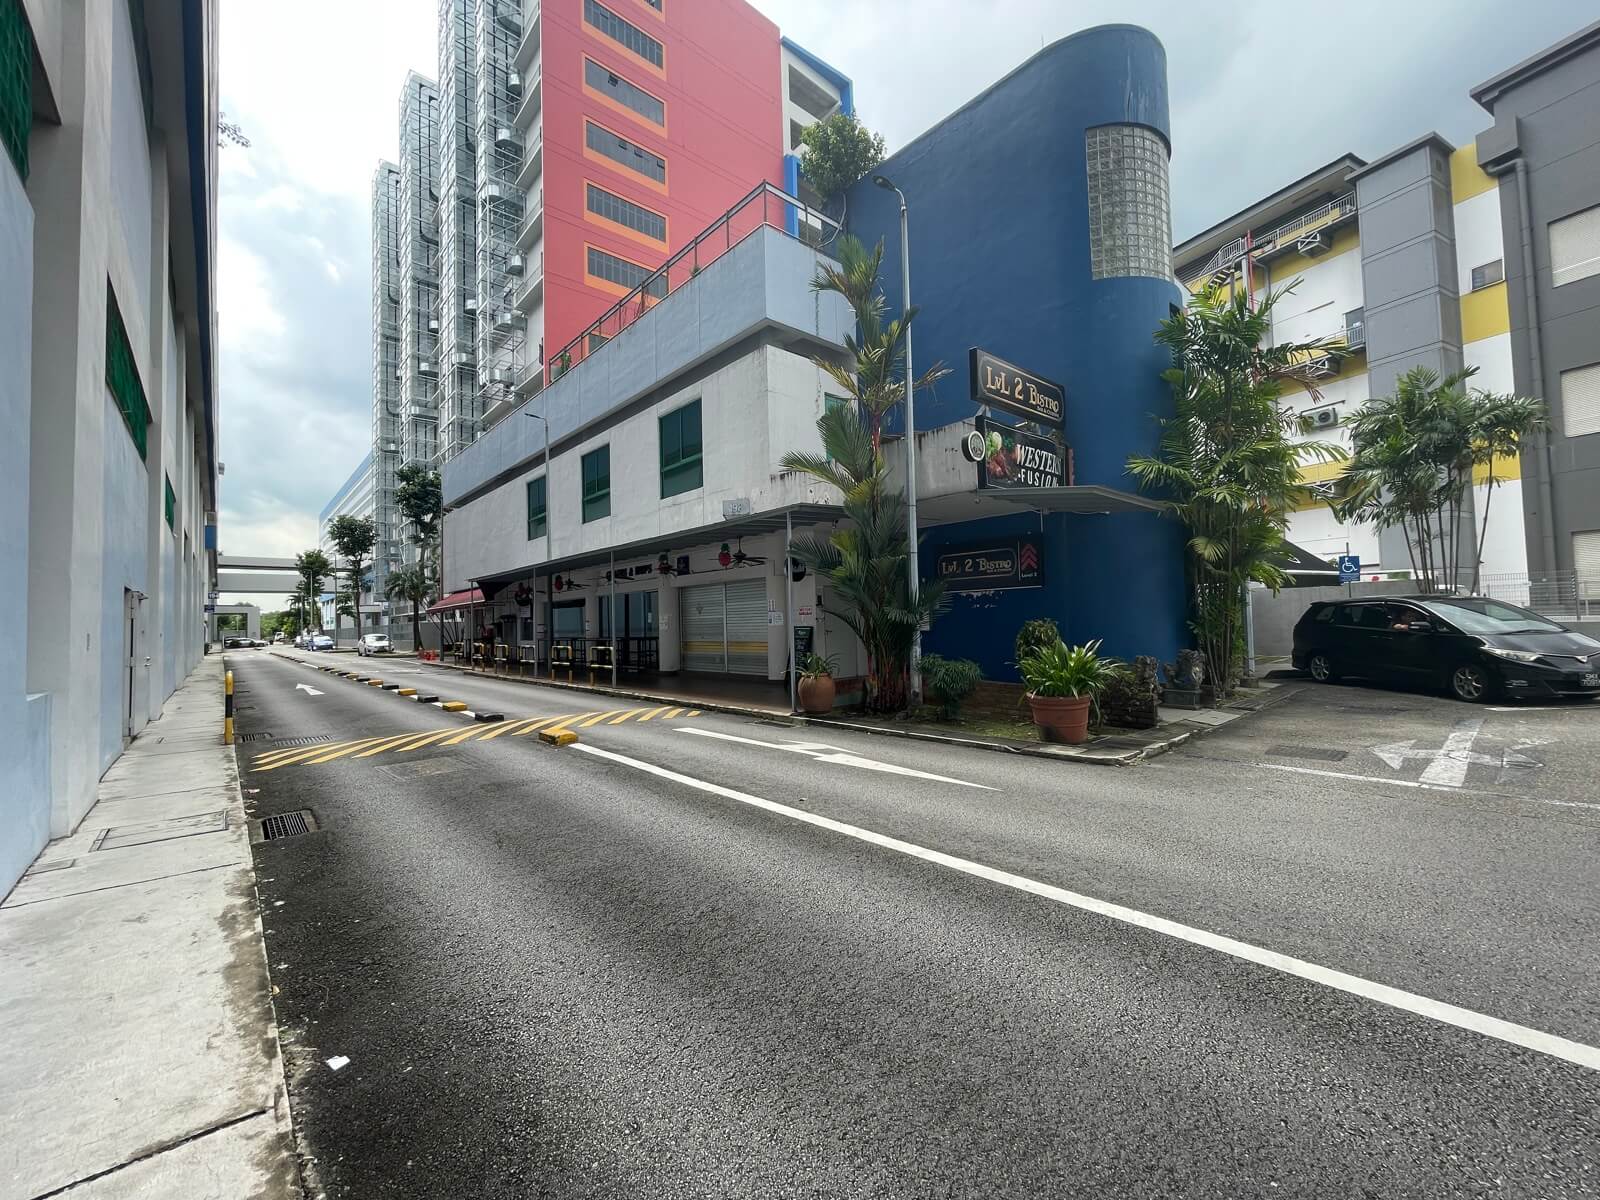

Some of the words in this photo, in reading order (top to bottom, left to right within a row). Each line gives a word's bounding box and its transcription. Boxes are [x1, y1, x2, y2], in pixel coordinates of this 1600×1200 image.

[1015, 377, 1024, 400] 2
[1016, 443, 1062, 476] WESTERN
[964, 559, 974, 572] 2
